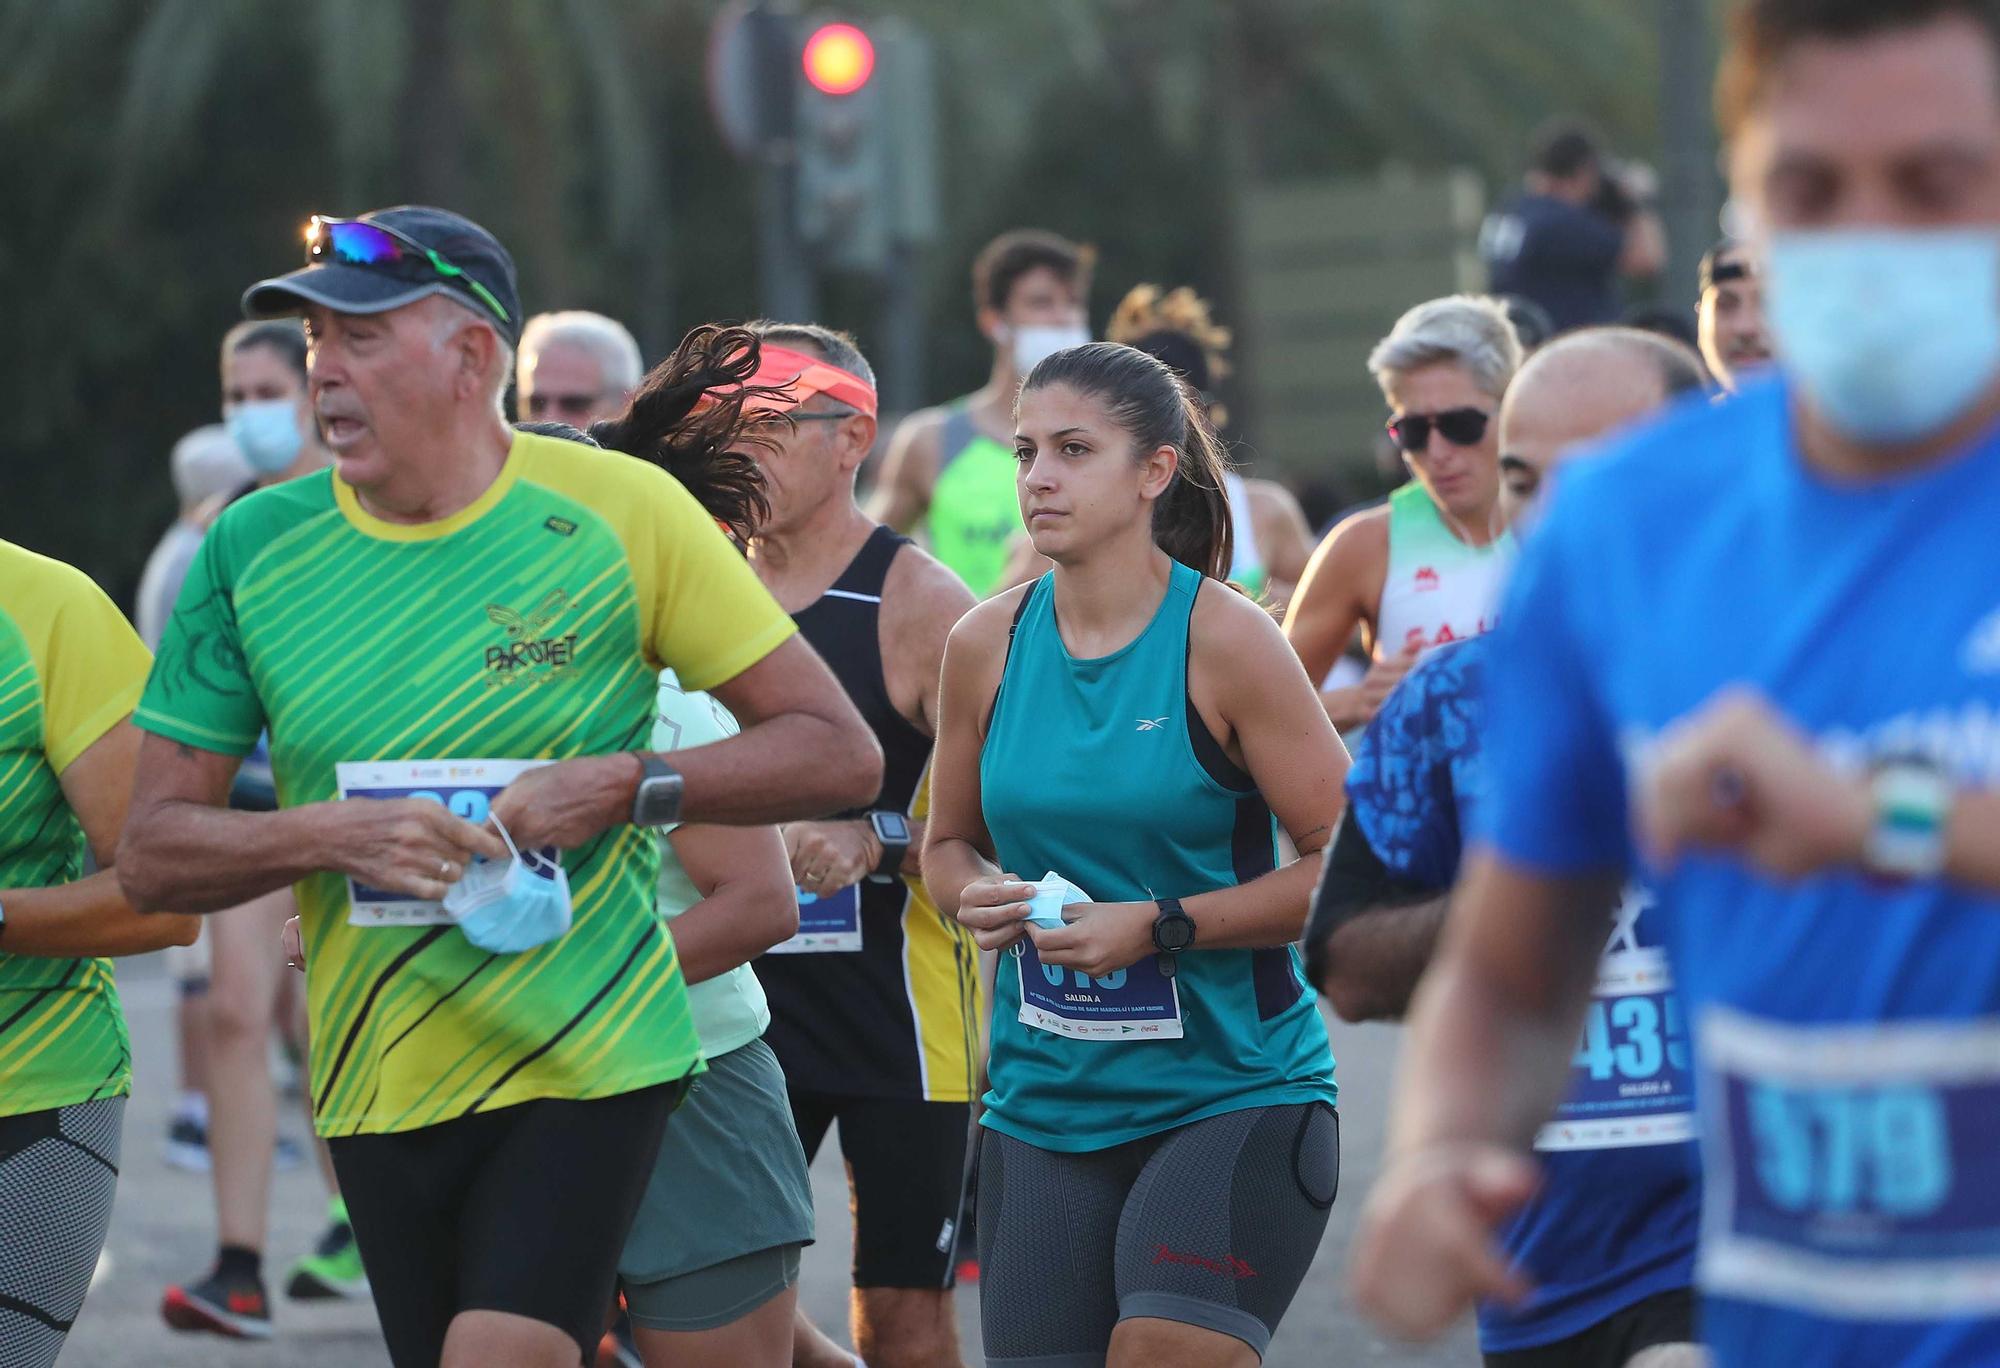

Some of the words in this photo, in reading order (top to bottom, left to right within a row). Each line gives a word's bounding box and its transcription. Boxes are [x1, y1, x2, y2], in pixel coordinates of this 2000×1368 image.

[486, 635, 577, 671] PAROTET
[1064, 993, 1093, 1003] SALIDA
[1094, 995, 1102, 1003] A
